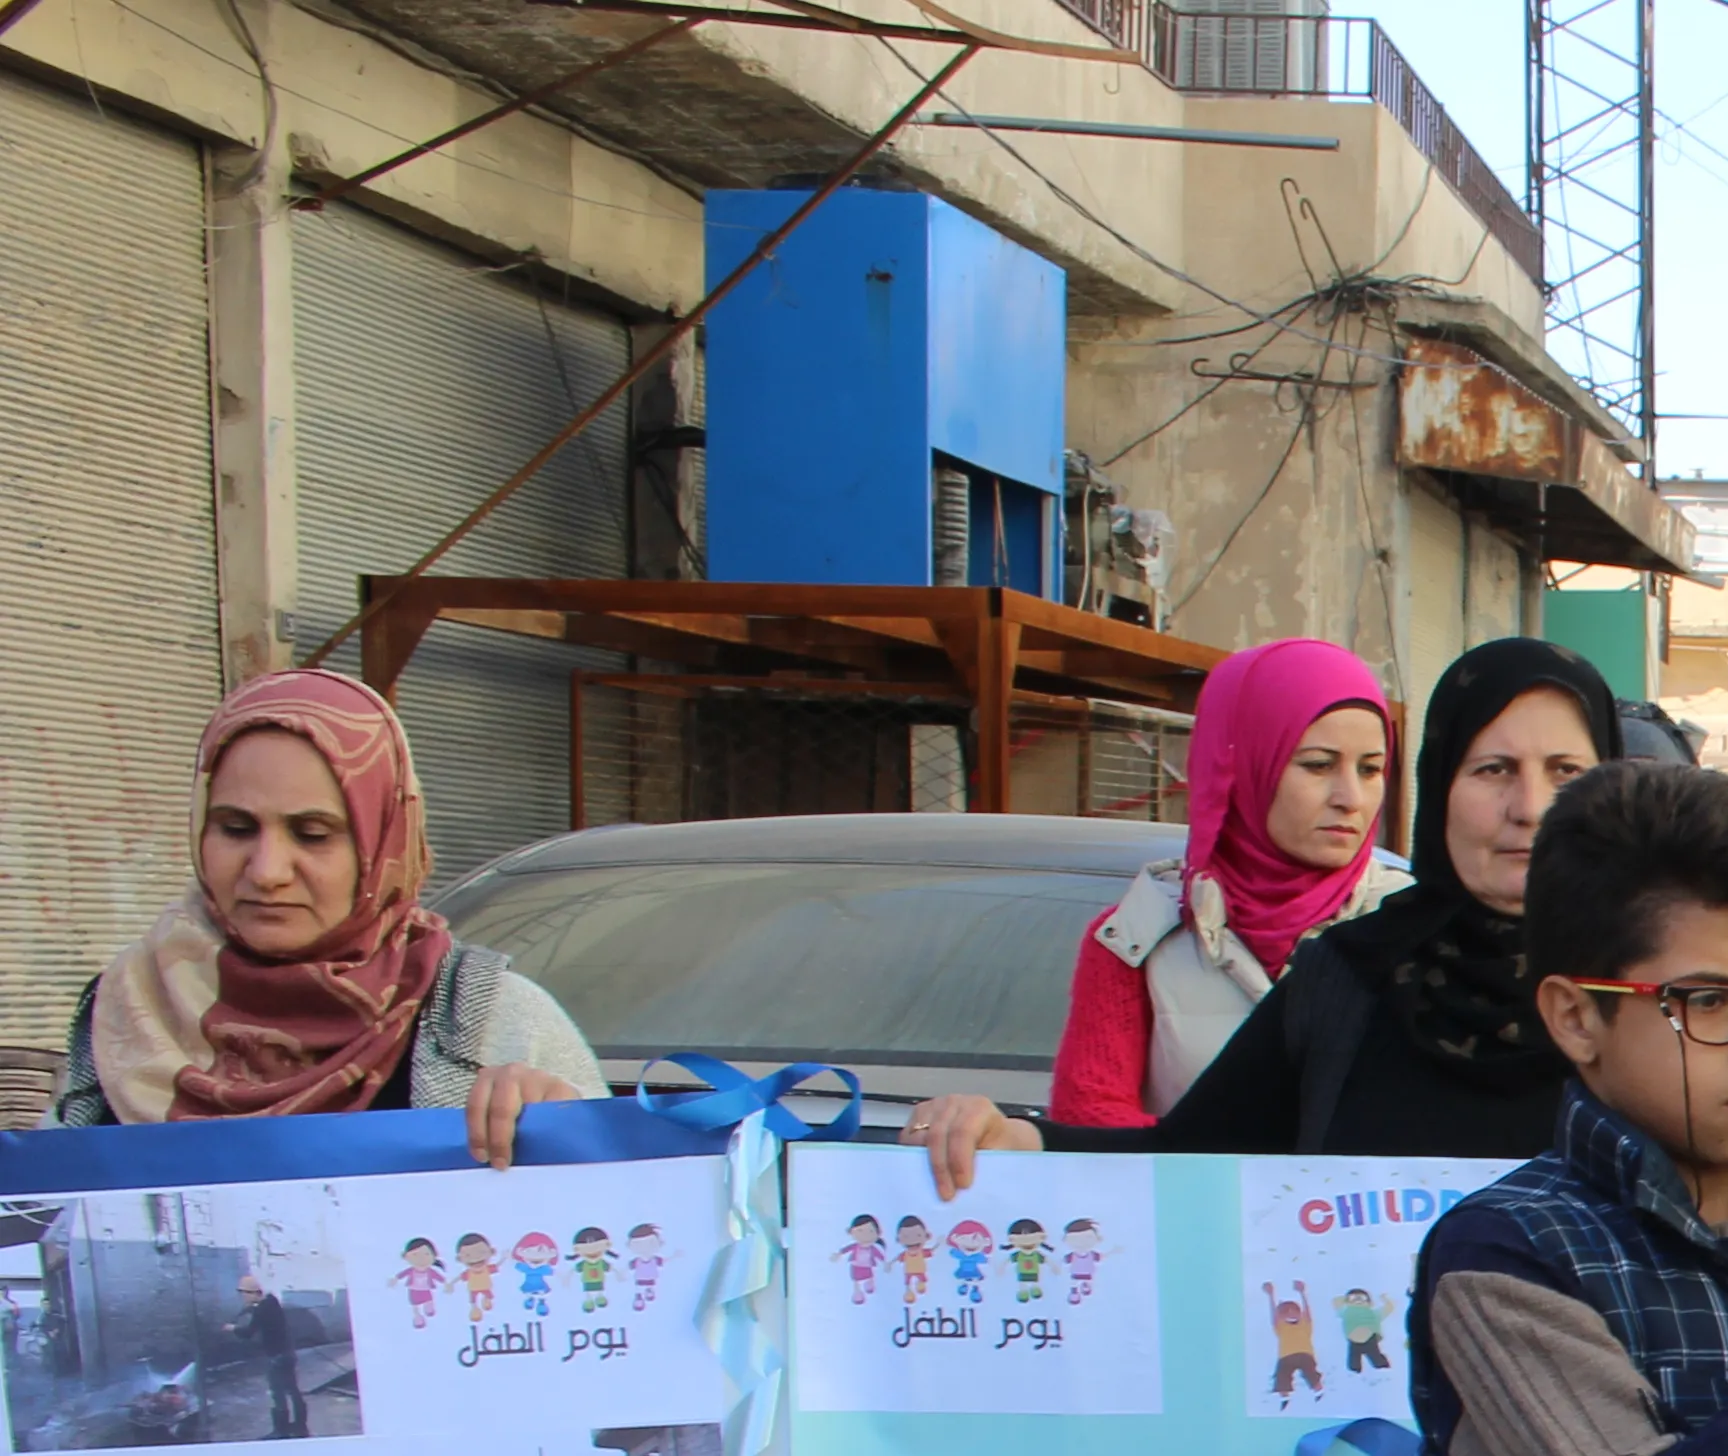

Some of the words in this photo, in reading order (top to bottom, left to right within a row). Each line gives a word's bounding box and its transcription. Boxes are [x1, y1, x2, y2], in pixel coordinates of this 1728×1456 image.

[1298, 1189, 1465, 1234] CHILD
[458, 1322, 544, 1367] الطفل
[561, 1326, 628, 1362] يوم
[892, 1307, 976, 1348] الطفل
[995, 1318, 1063, 1350] يوم
